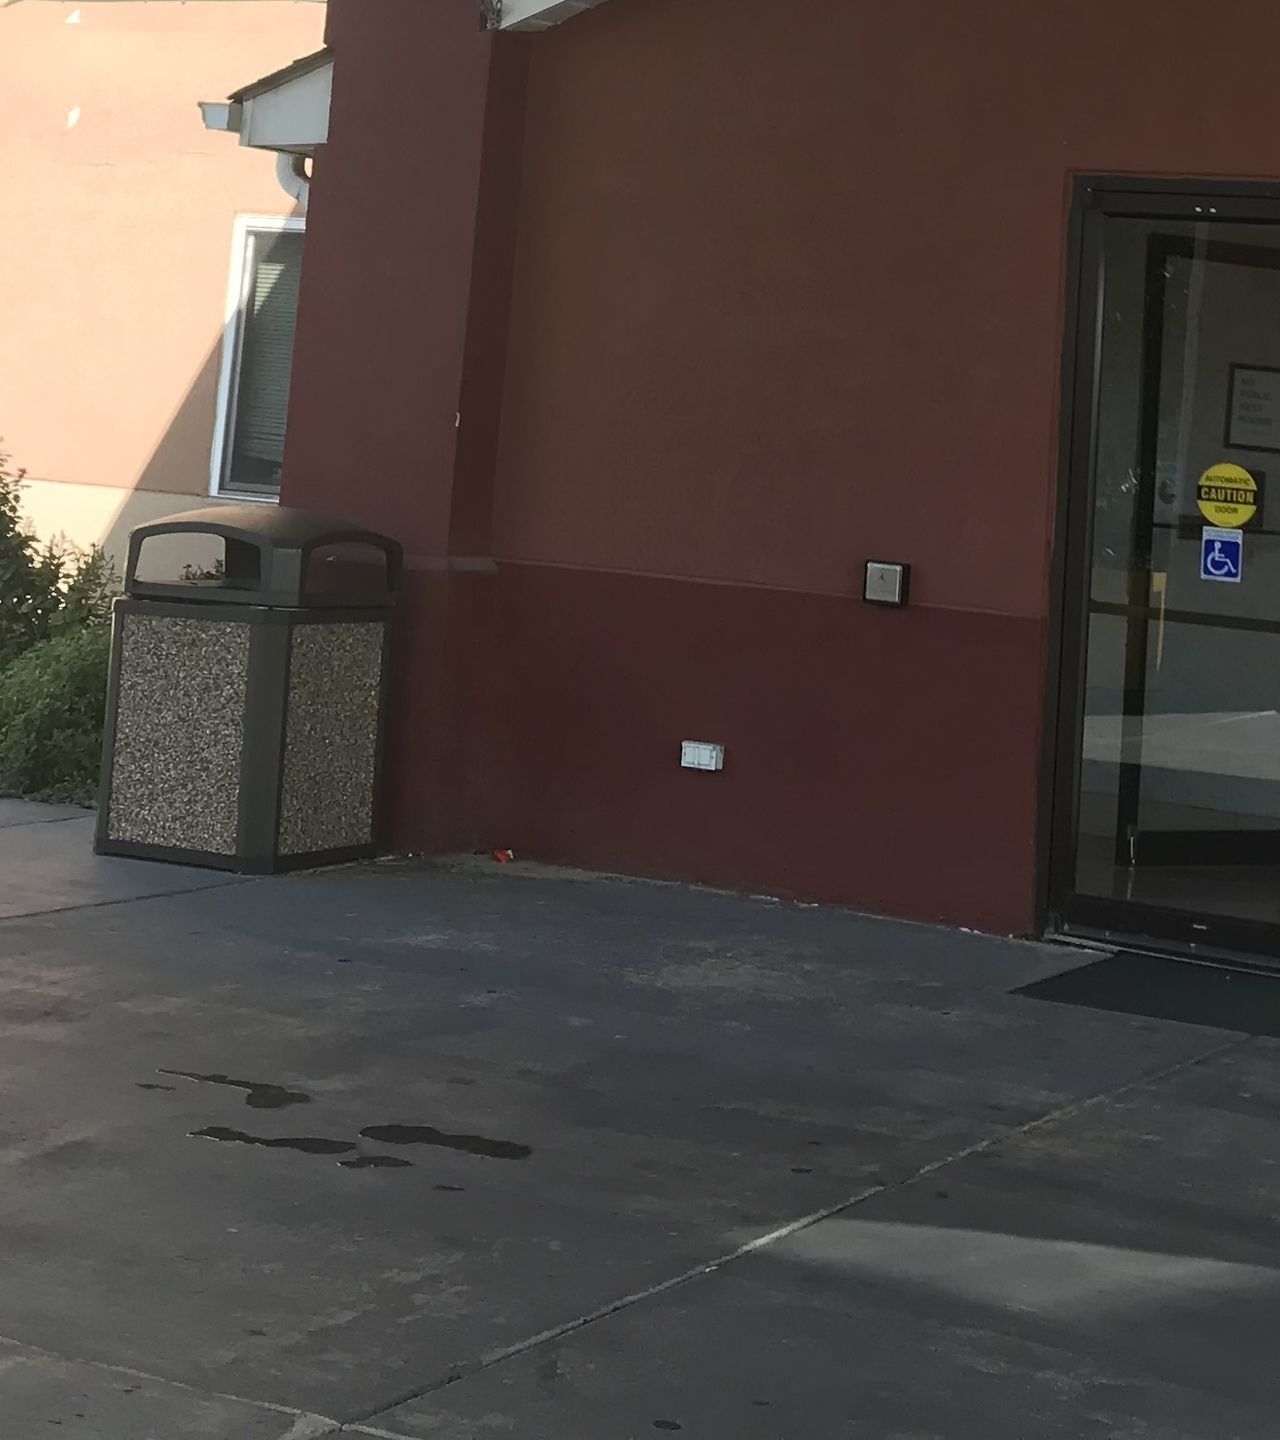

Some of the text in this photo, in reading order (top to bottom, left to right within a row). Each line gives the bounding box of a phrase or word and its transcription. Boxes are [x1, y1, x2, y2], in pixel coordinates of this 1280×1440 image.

[1205, 474, 1251, 486] AUTOMATIC
[1200, 487, 1255, 504] CAUTION
[1214, 505, 1239, 515] DOOR
